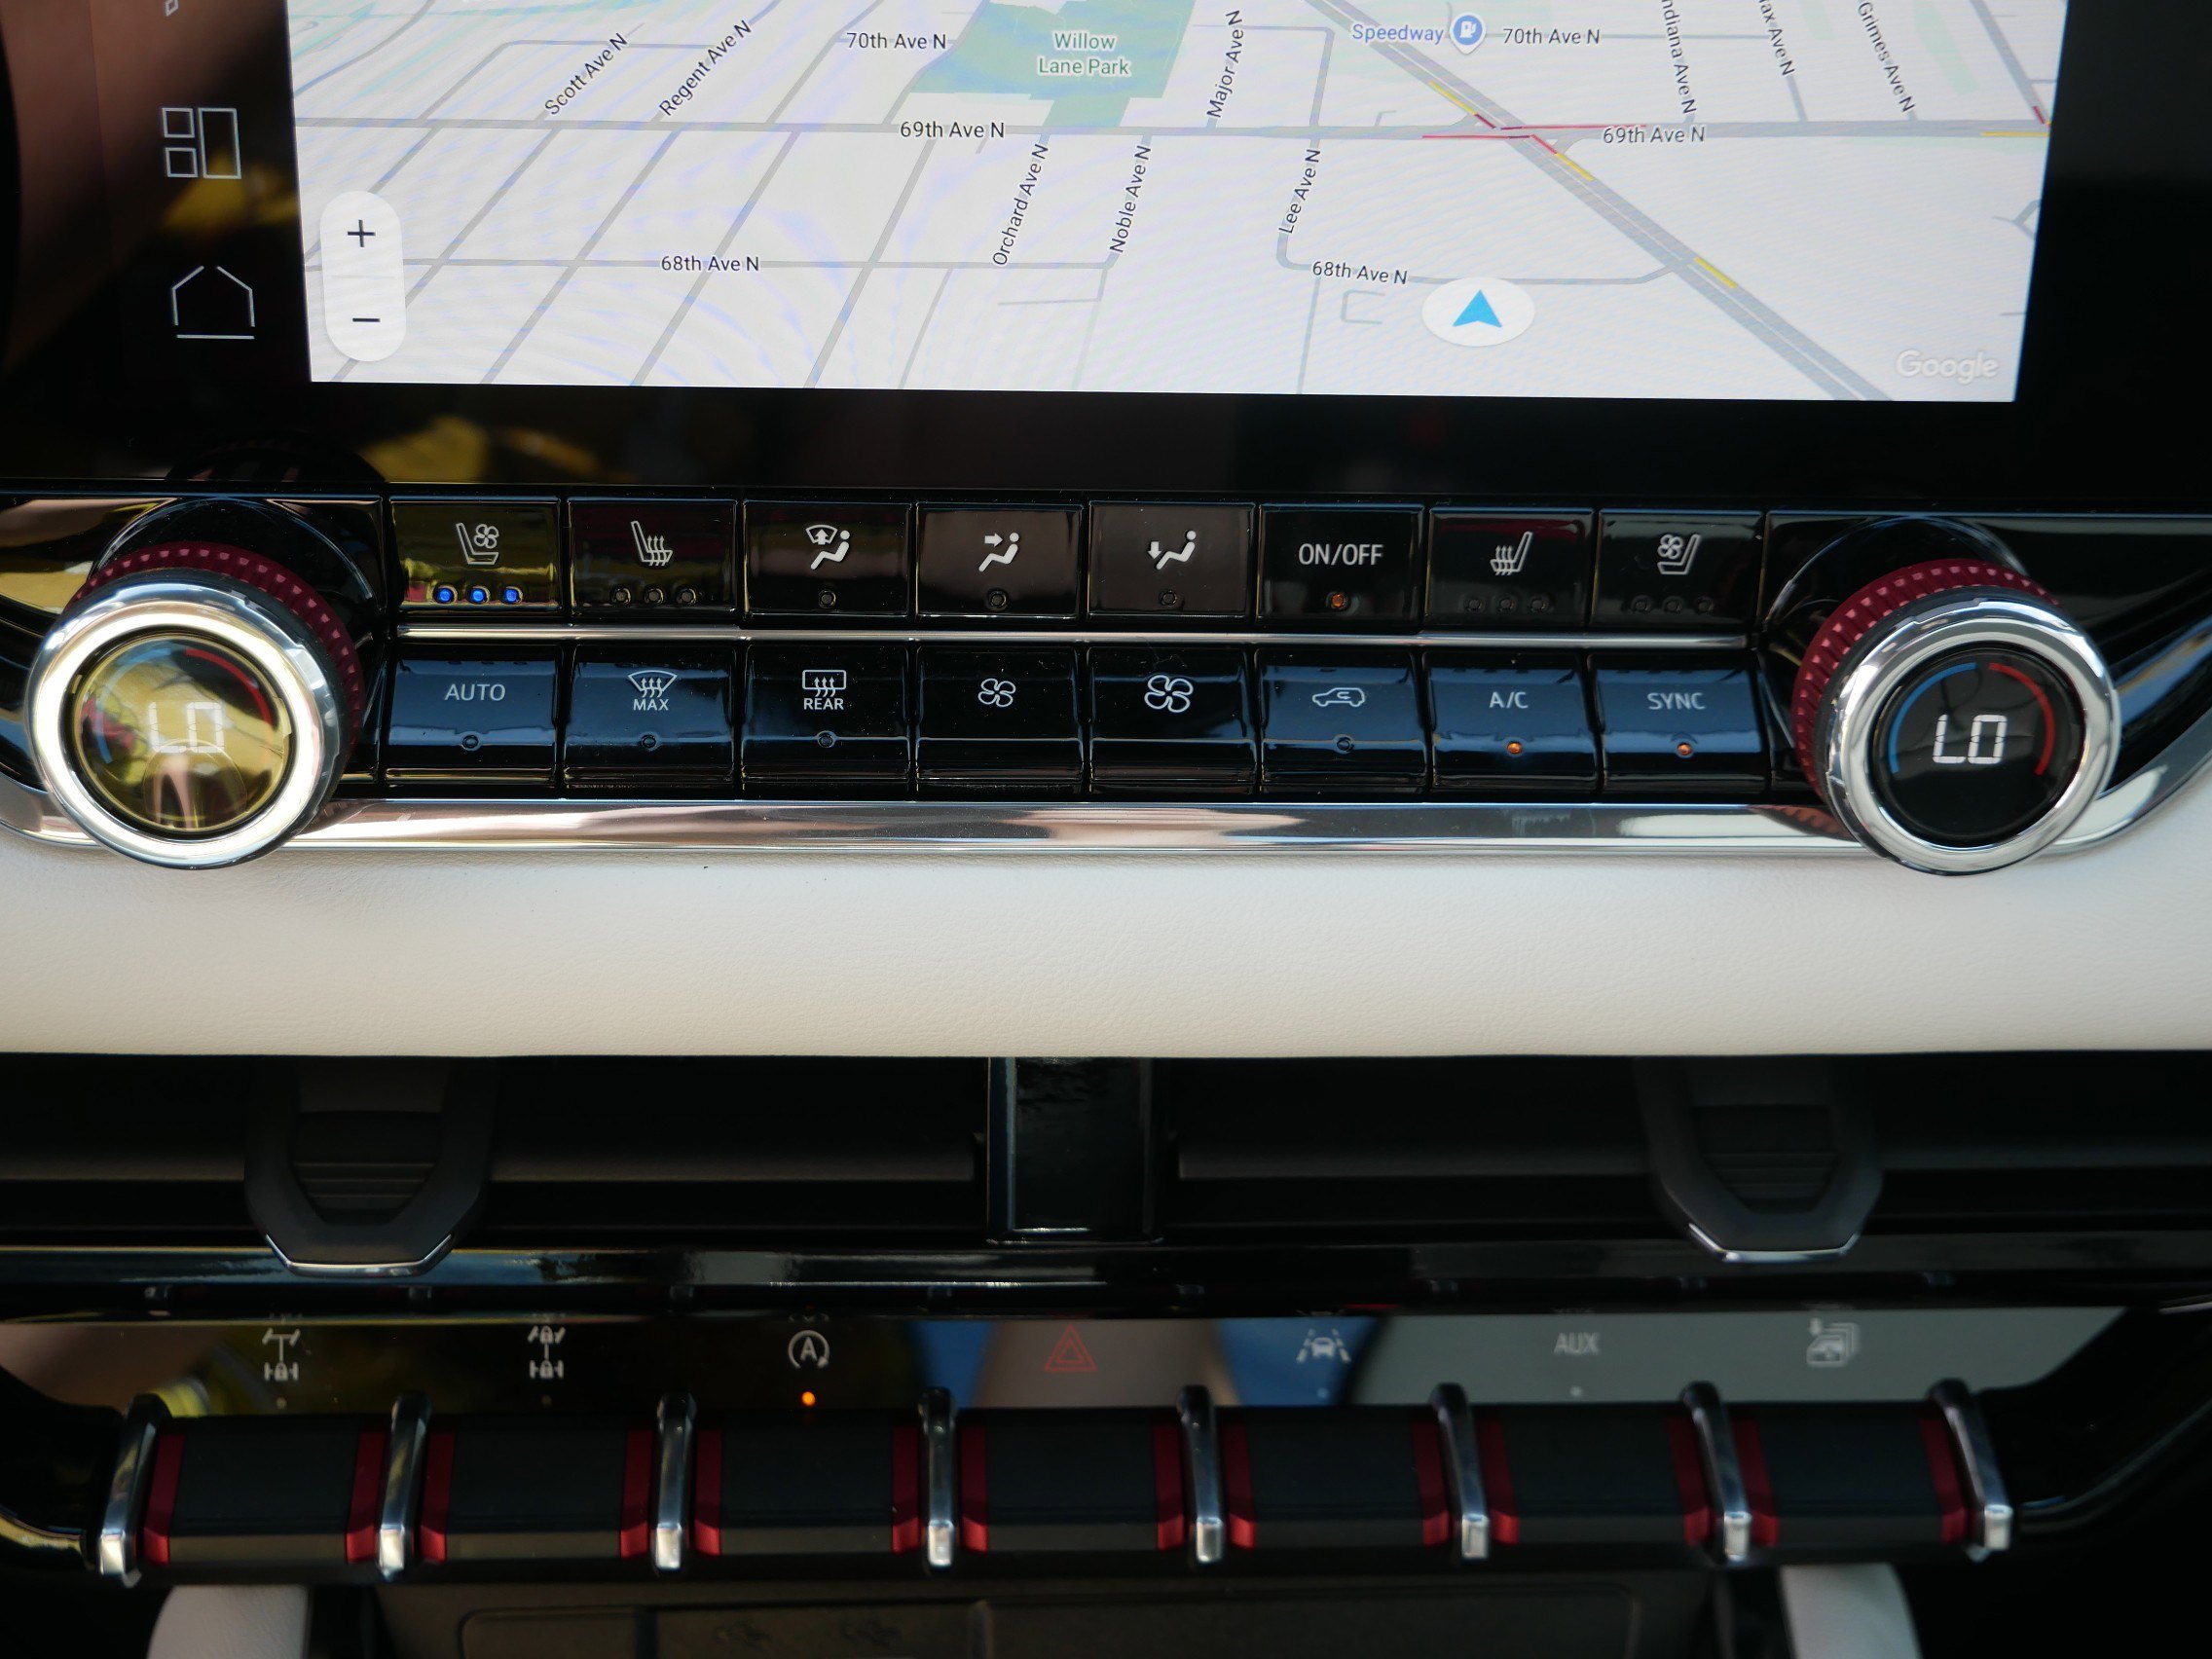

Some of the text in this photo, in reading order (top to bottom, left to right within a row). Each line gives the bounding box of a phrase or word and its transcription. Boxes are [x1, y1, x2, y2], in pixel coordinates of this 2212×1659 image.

[846, 32, 946, 49] 70th Ave N
[1054, 32, 1116, 49] Willow
[1352, 23, 1445, 45] Speedway
[1503, 27, 1601, 45] 70th Ave N
[1768, 26, 1793, 58] Ave
[659, 19, 752, 116] Regent Ave N
[1039, 57, 1128, 75] Lane Park
[1206, 10, 1244, 118] Major Ave N
[1779, 59, 1795, 77] N
[1858, 1, 1916, 113] Grimes Ave N
[544, 32, 627, 115] Scott Ave N
[1674, 62, 1689, 96] Ave
[1681, 98, 1697, 115] N
[900, 121, 1005, 138] 69th Ave N
[1603, 126, 1705, 144] 69th Ave N
[1109, 145, 1152, 253] Noble Ave N
[1278, 148, 1321, 234] Lee Ave N
[992, 144, 1049, 266] Orchard Ave N
[661, 255, 760, 272] 68th Ave N
[1312, 260, 1408, 285] 68th Ave N
[1896, 349, 2000, 386] Google
[1298, 542, 1384, 568] ON/OFF
[444, 682, 506, 703] AUTO
[803, 696, 845, 711] REAR
[1489, 690, 1530, 711] A/C
[1647, 691, 1706, 711] SYNC
[633, 697, 671, 712] MAX
[1932, 714, 2009, 765] LO
[1554, 1331, 1601, 1355] AUX
